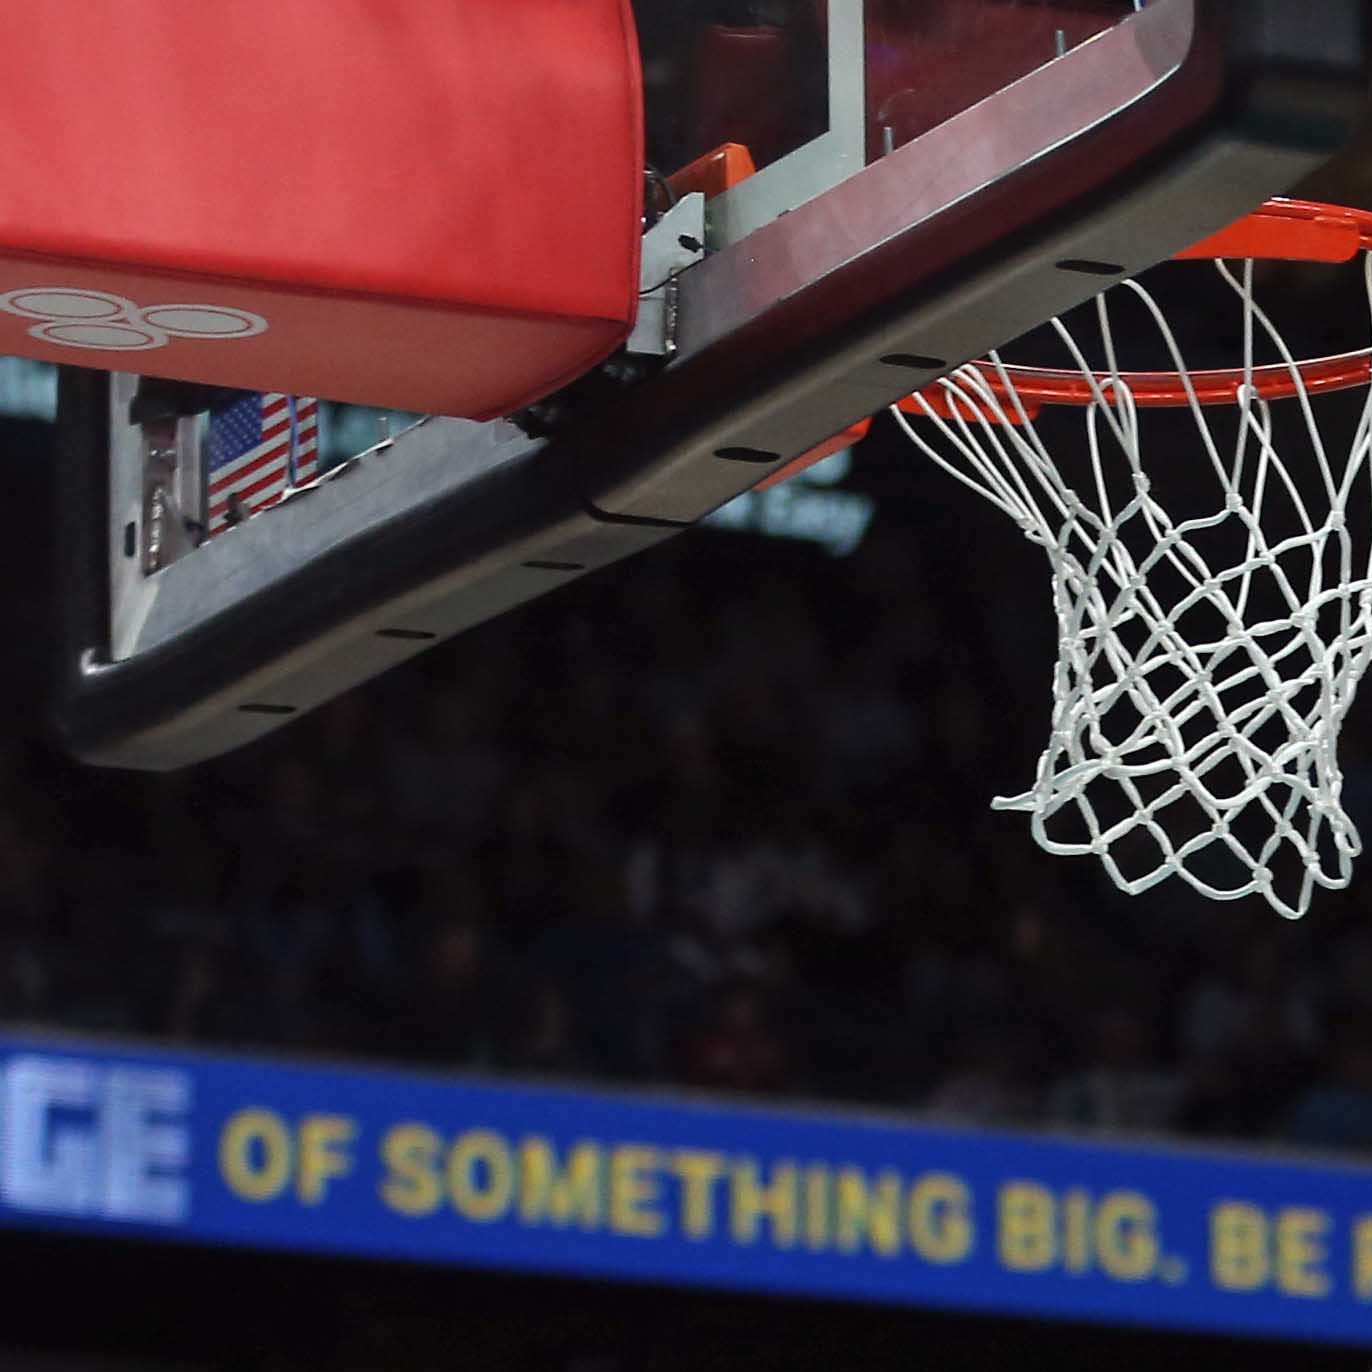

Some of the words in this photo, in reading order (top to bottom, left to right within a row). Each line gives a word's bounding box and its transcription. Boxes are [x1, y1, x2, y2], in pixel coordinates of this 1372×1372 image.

[219, 1107, 354, 1206] OF
[380, 1121, 972, 1265] SOMETHING
[995, 1181, 1186, 1284] BIG.
[1210, 1200, 1334, 1299] BE
